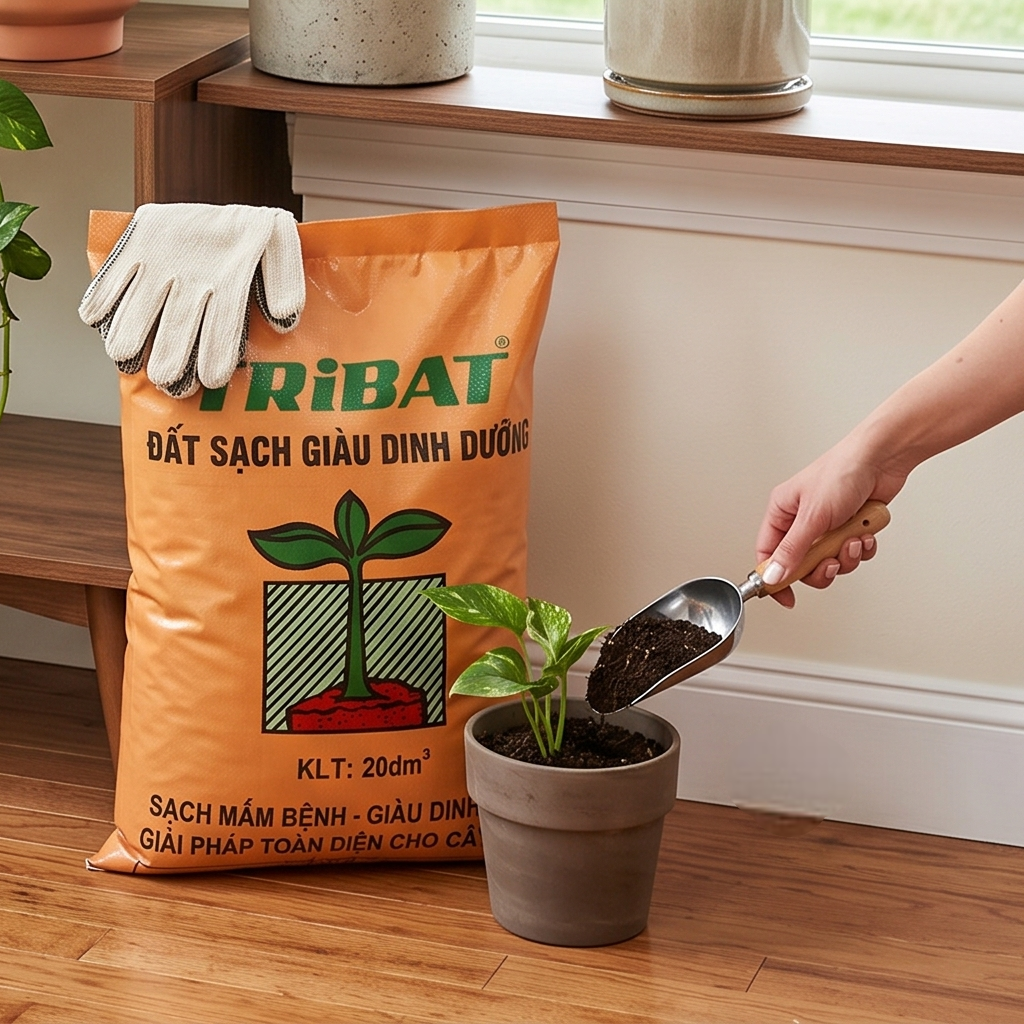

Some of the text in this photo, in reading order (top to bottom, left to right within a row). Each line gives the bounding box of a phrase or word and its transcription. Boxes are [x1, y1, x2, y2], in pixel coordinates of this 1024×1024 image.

[146, 418, 529, 474] ĐẤT SẠCH GIÀU DINH DƯỠNG
[297, 757, 353, 780] KLT:
[149, 794, 212, 825] SẠCH
[218, 797, 274, 827] MẤM
[281, 802, 347, 832] BỆNH
[366, 798, 423, 825] GIÀU
[139, 823, 483, 855] GIẢI PHÁP TOÀN DIỆN CHO CÂ
